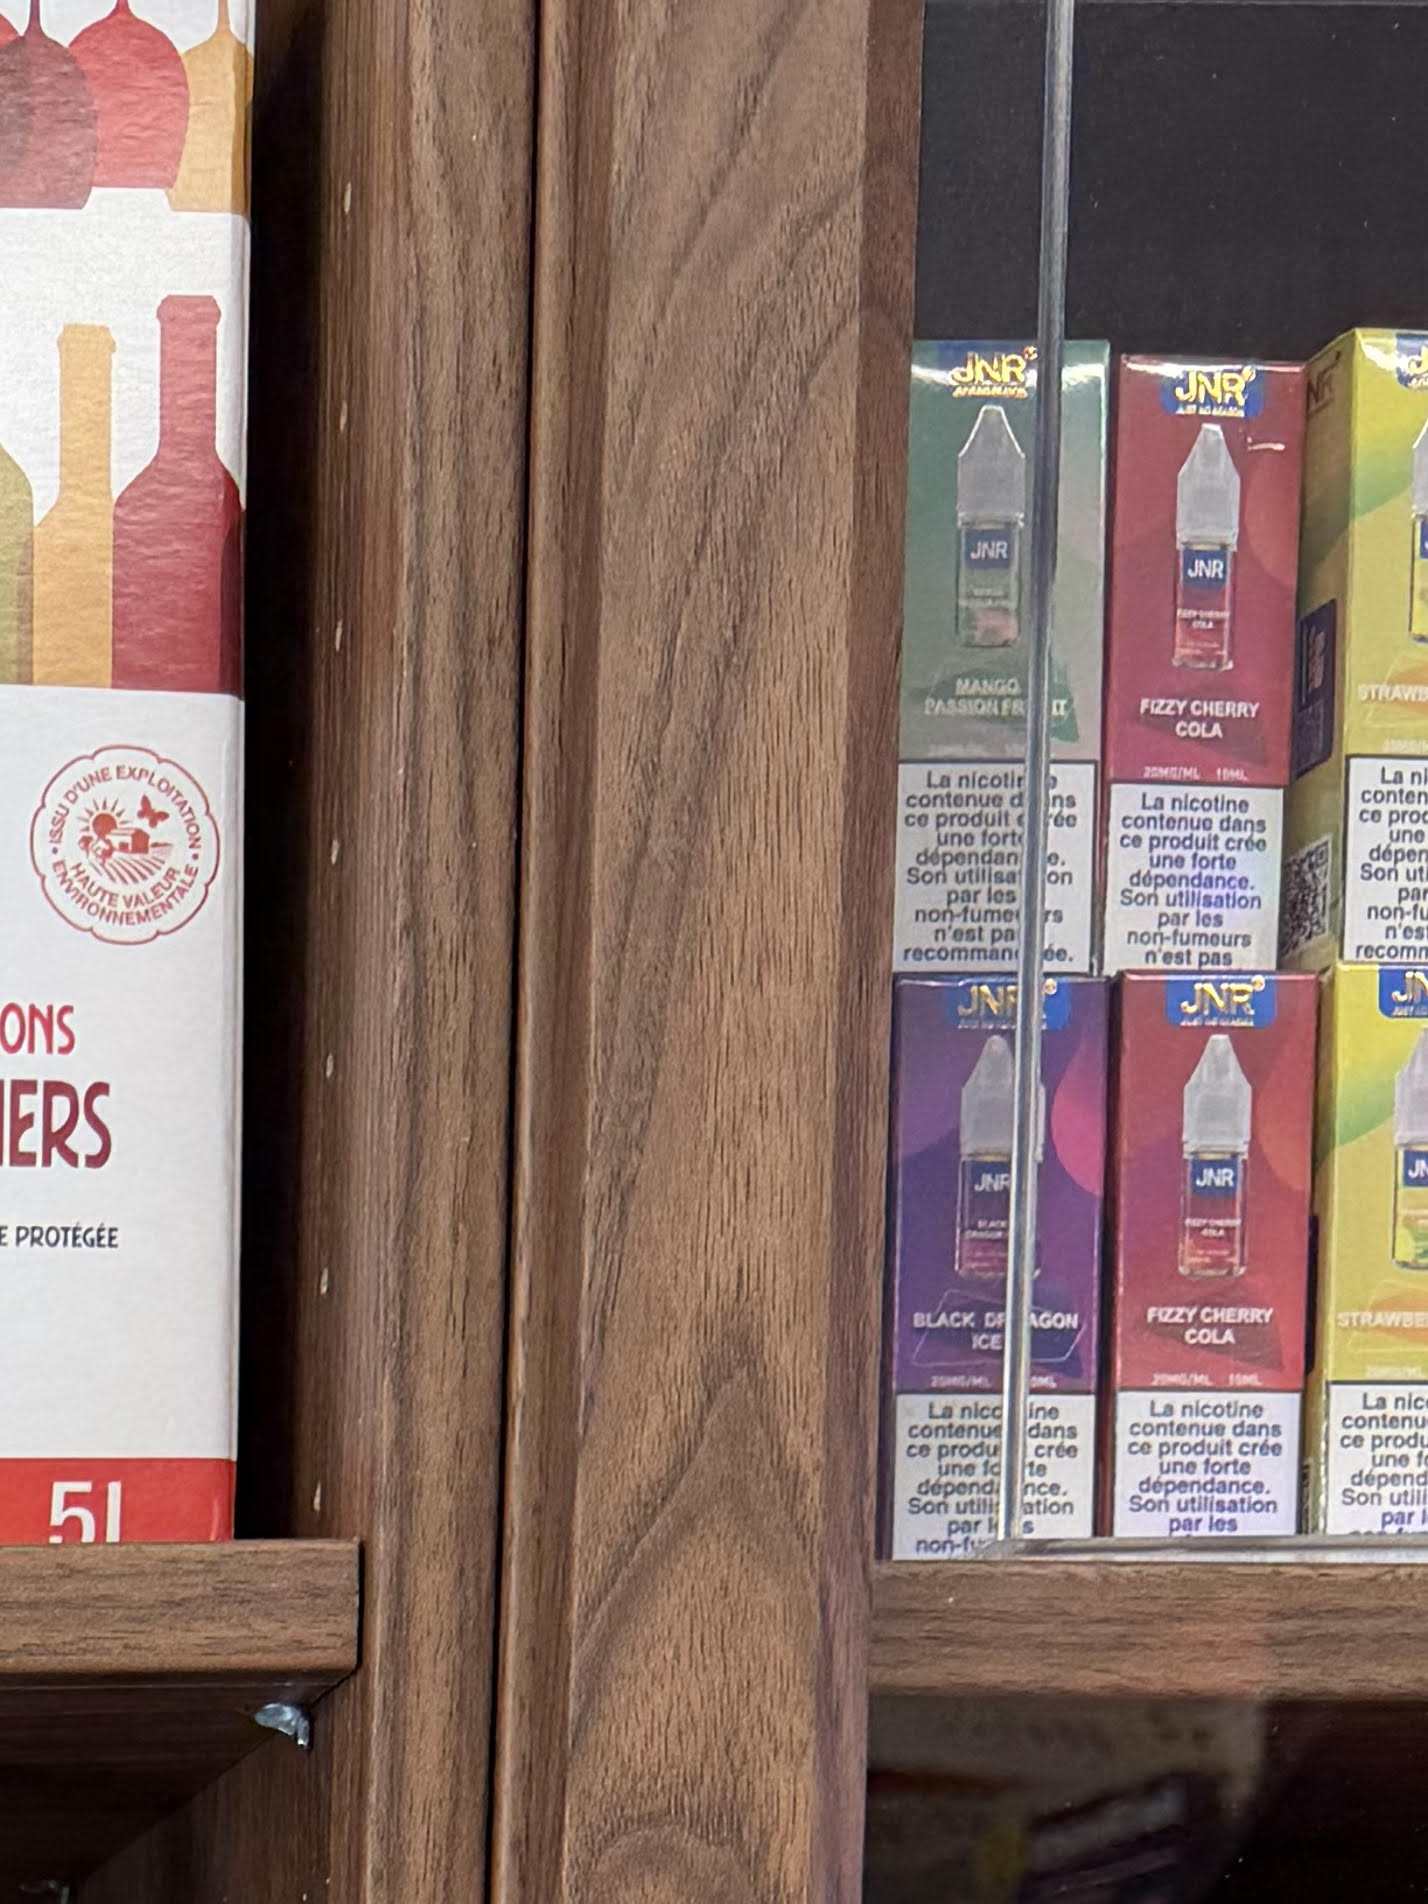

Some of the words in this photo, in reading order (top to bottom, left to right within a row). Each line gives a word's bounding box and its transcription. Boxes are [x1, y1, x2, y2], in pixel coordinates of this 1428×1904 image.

[970, 542, 1008, 560] JNR
[1188, 560, 1223, 577] JNR
[1140, 699, 1187, 715] FIZZY
[1190, 700, 1260, 718] CHERRY
[1176, 721, 1223, 738] COLA
[116, 765, 201, 849] EXPLOITATION
[1142, 792, 1163, 810] La
[1170, 794, 1249, 813] nicotine
[1121, 814, 1213, 831] contenue
[1220, 816, 1266, 834] dans
[1120, 835, 1142, 847] ce
[1149, 833, 1220, 855] produit
[1225, 833, 1266, 851] crée
[1149, 853, 1185, 868] une
[1192, 852, 1236, 870] forte
[71, 862, 119, 907] HAUTE
[122, 867, 180, 908] VALEUR
[1129, 870, 1255, 891] dépendance.
[53, 861, 198, 925] ENVIRONNEMENTALE
[1121, 889, 1158, 906] Son
[1165, 890, 1261, 909] utilisation
[1158, 911, 1189, 928] par
[1196, 909, 1223, 927] les
[1127, 928, 1252, 947] non-fumeurs
[1145, 948, 1190, 965] n'est
[1199, 950, 1232, 967] pas
[1196, 1169, 1233, 1187] JNR
[16, 1221, 118, 1249] PROTÉGÉE
[913, 1313, 974, 1328] BLACK
[1147, 1307, 1197, 1323] FIZZY
[1200, 1307, 1273, 1323] CHERRY
[972, 1335, 1002, 1349] ICE
[1185, 1329, 1235, 1344] COLA
